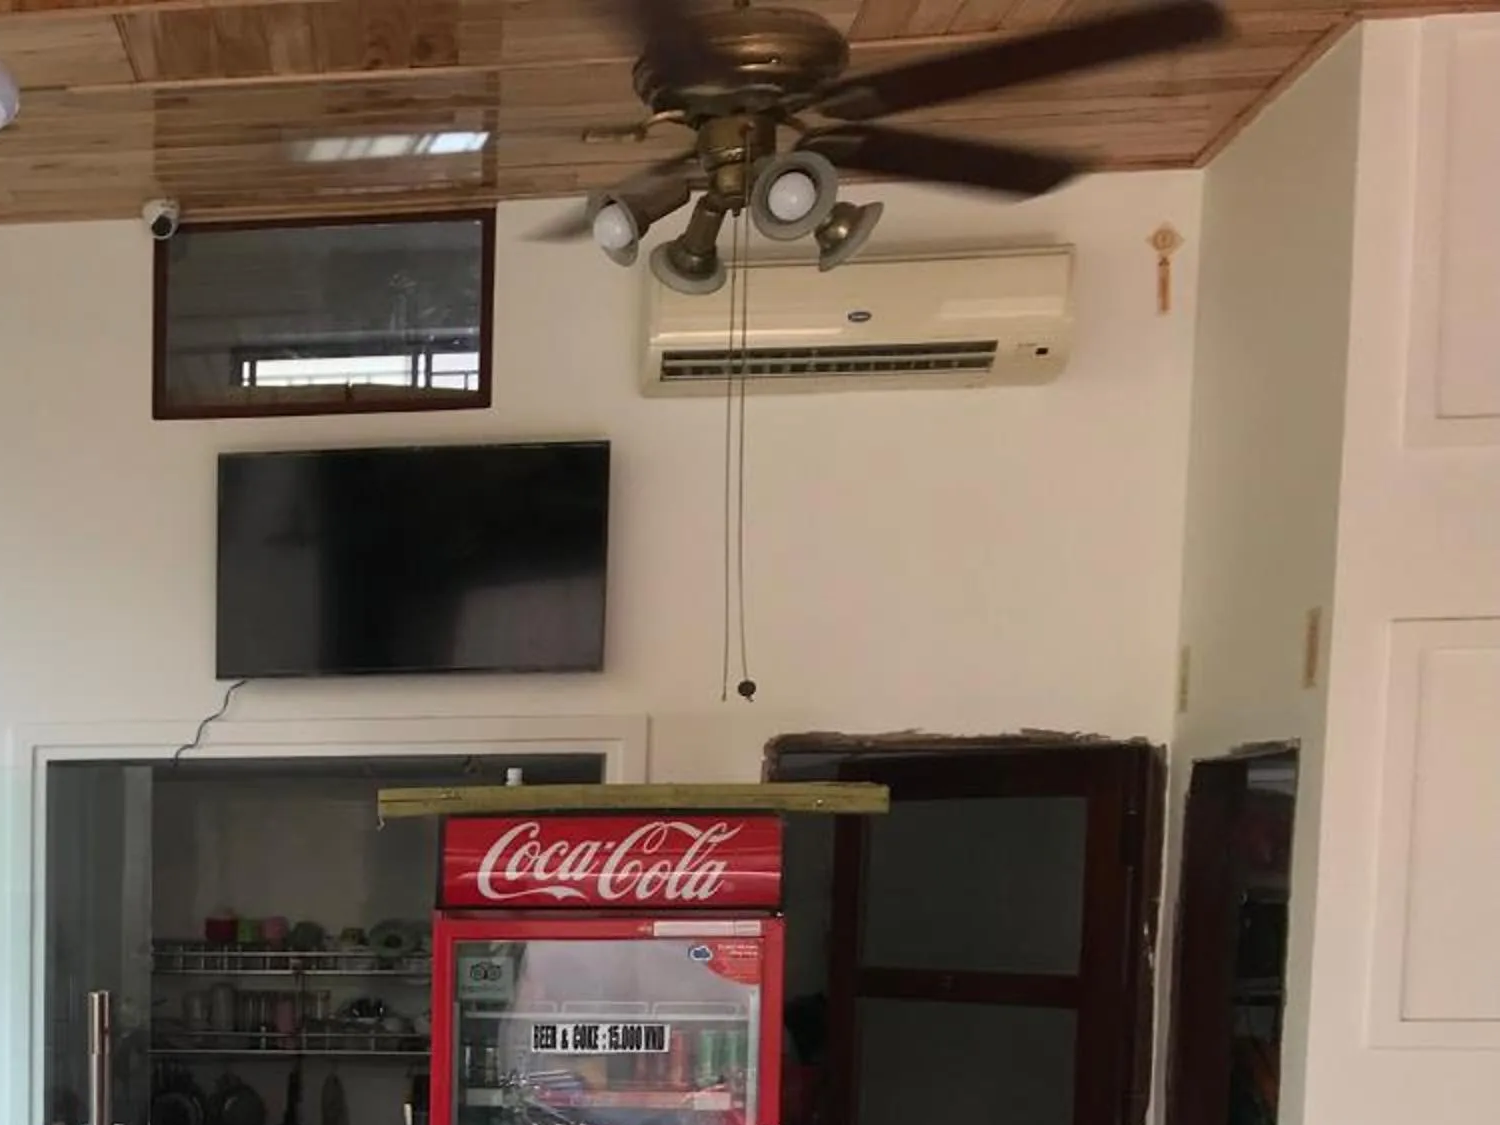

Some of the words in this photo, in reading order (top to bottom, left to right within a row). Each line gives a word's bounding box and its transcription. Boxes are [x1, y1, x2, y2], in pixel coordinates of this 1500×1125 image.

[477, 821, 743, 901] Coca-Cola
[533, 1025, 557, 1050] BEER
[561, 1027, 569, 1050] &
[573, 1025, 600, 1050] COKE
